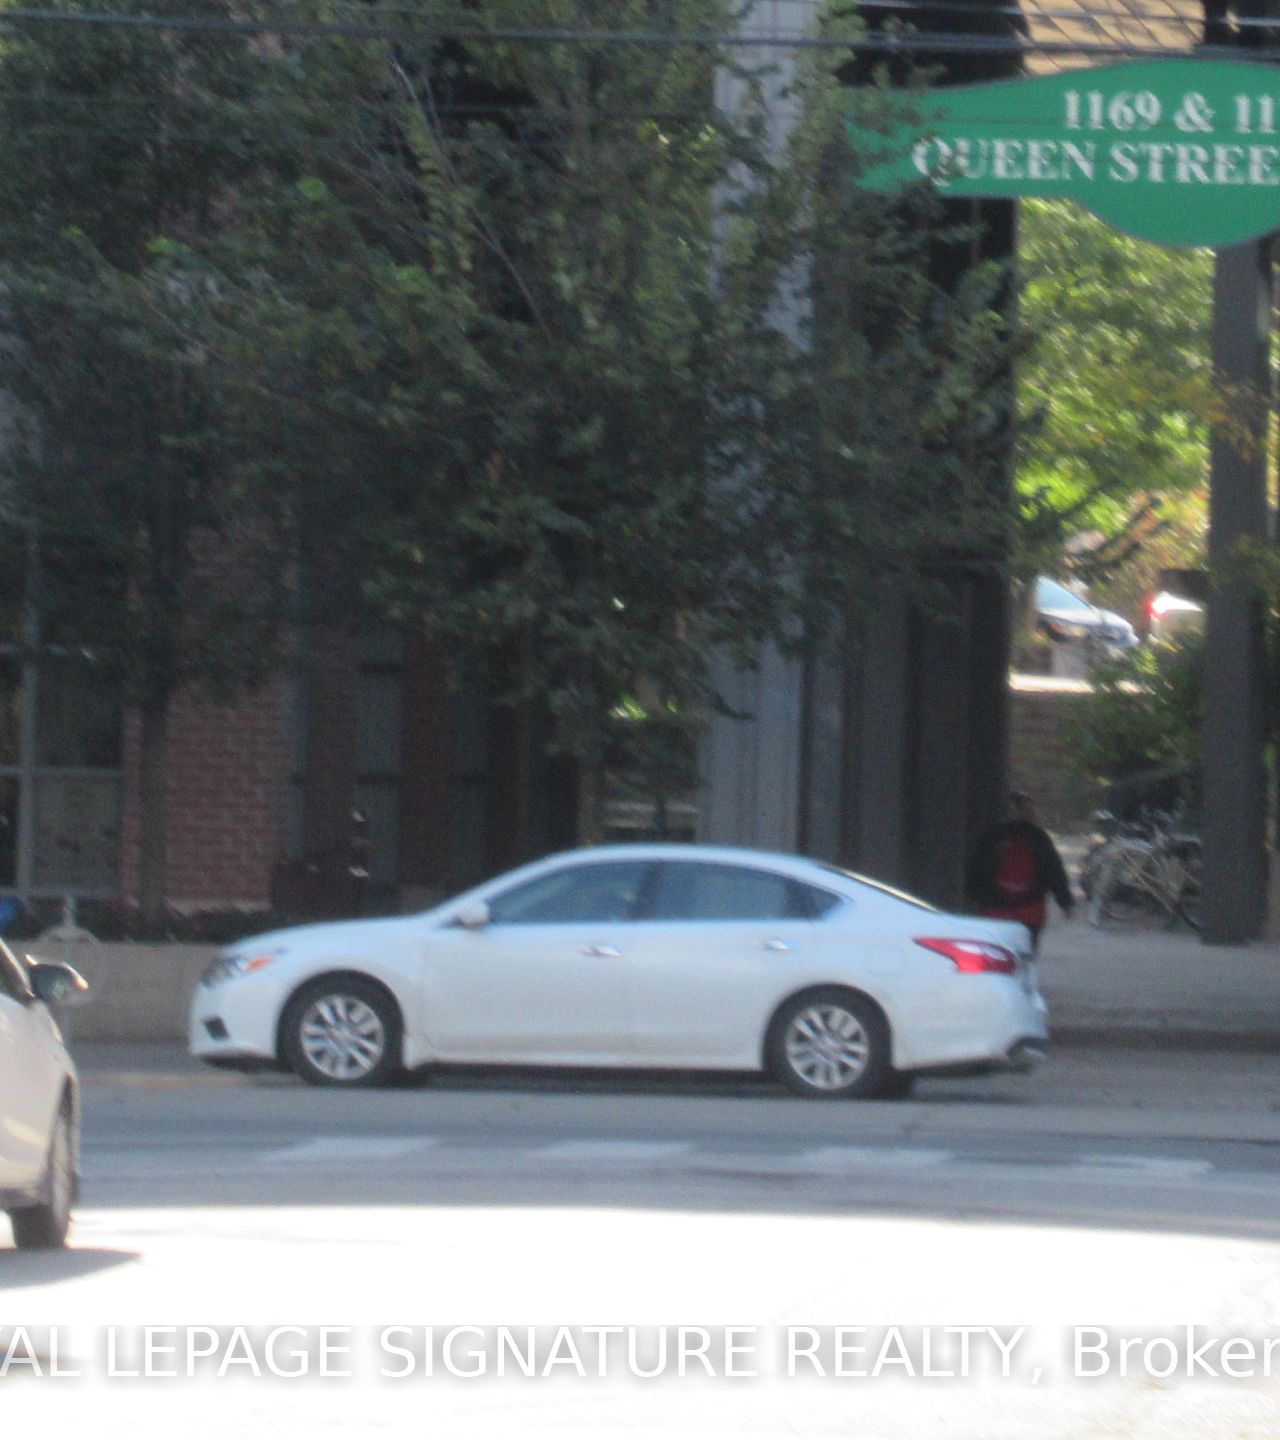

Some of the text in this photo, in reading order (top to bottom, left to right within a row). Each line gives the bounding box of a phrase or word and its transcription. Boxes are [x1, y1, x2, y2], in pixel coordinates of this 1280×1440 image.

[1062, 89, 1163, 131] 1169
[1173, 90, 1215, 133] &
[911, 136, 1096, 188] QUEEN
